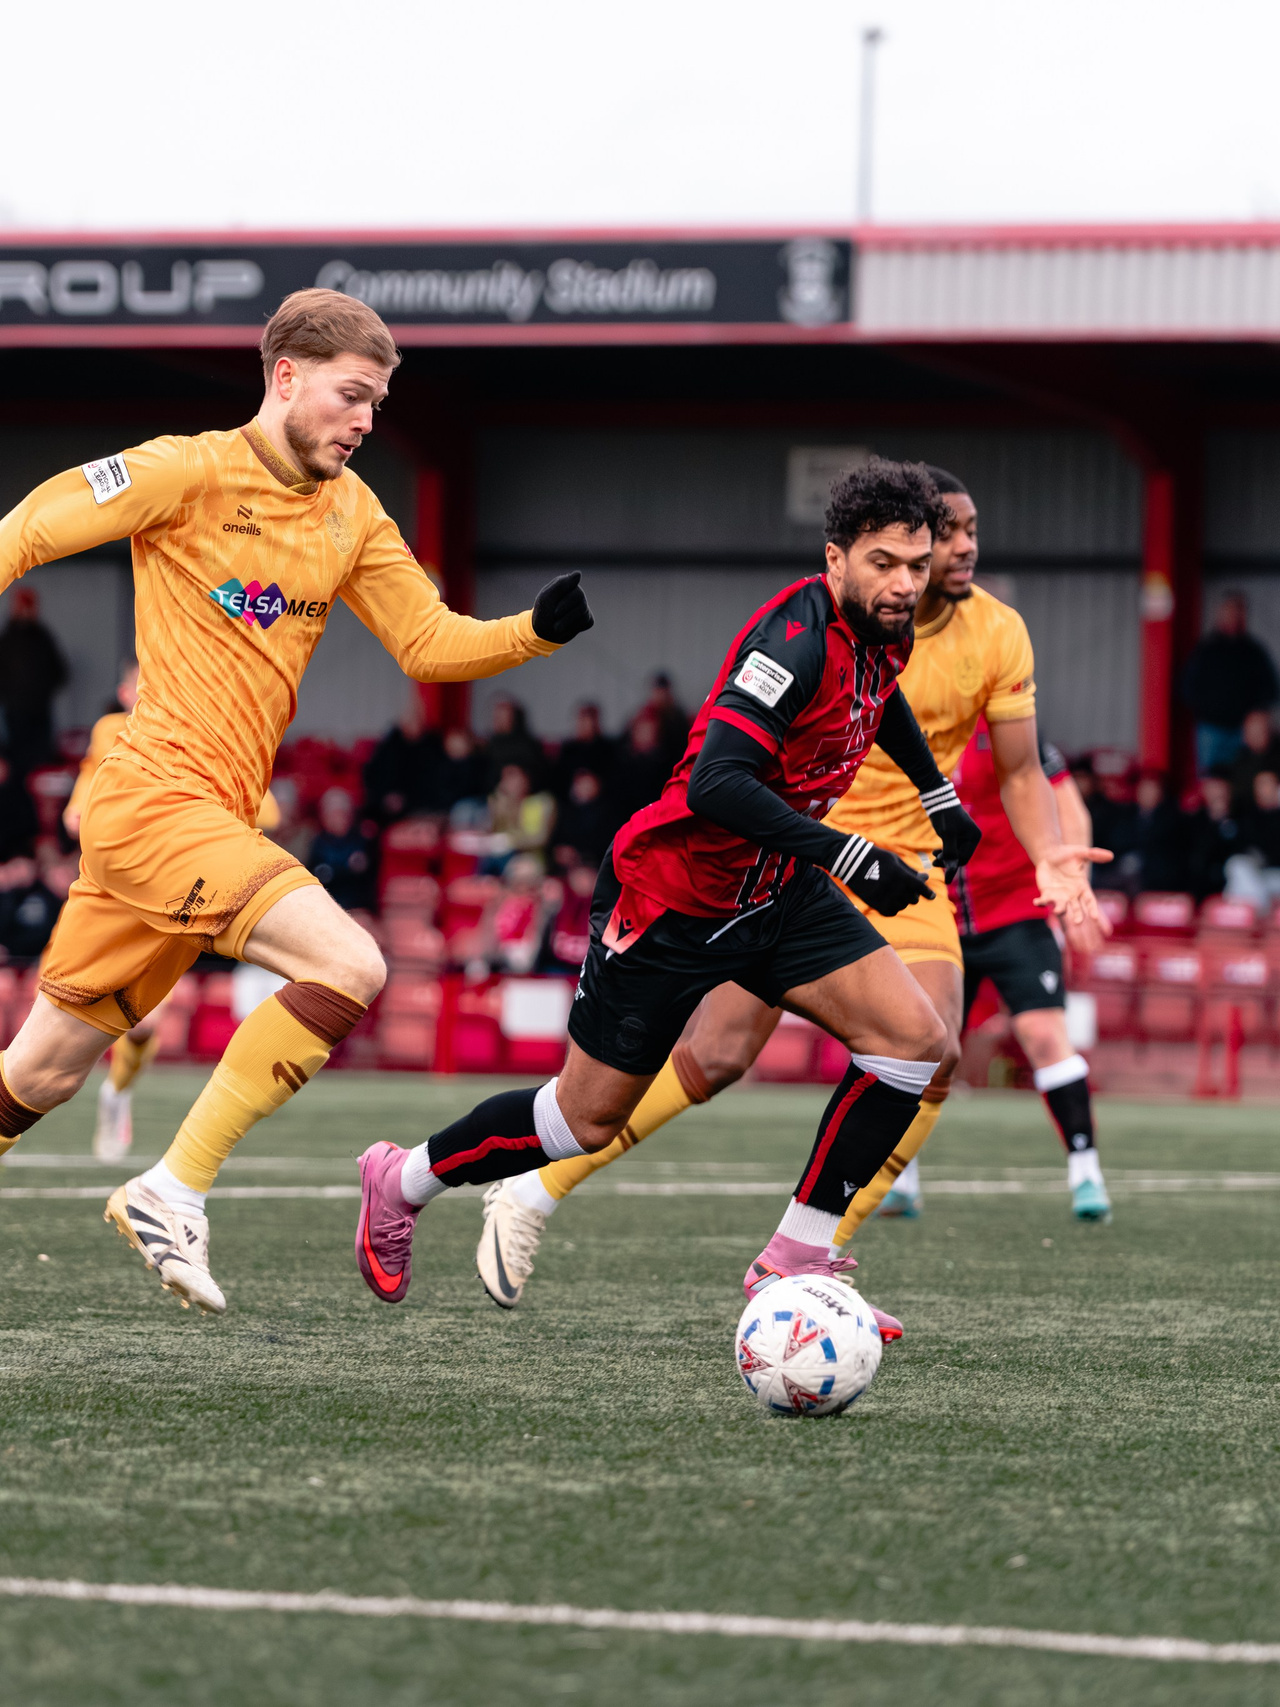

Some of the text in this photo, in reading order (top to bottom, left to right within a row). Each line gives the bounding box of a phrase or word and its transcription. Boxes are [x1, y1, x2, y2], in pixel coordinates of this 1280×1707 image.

[543, 258, 717, 315] Stadium
[286, 599, 328, 617] MED
[750, 657, 787, 686] enterprise
[754, 675, 777, 694] NATIONAL
